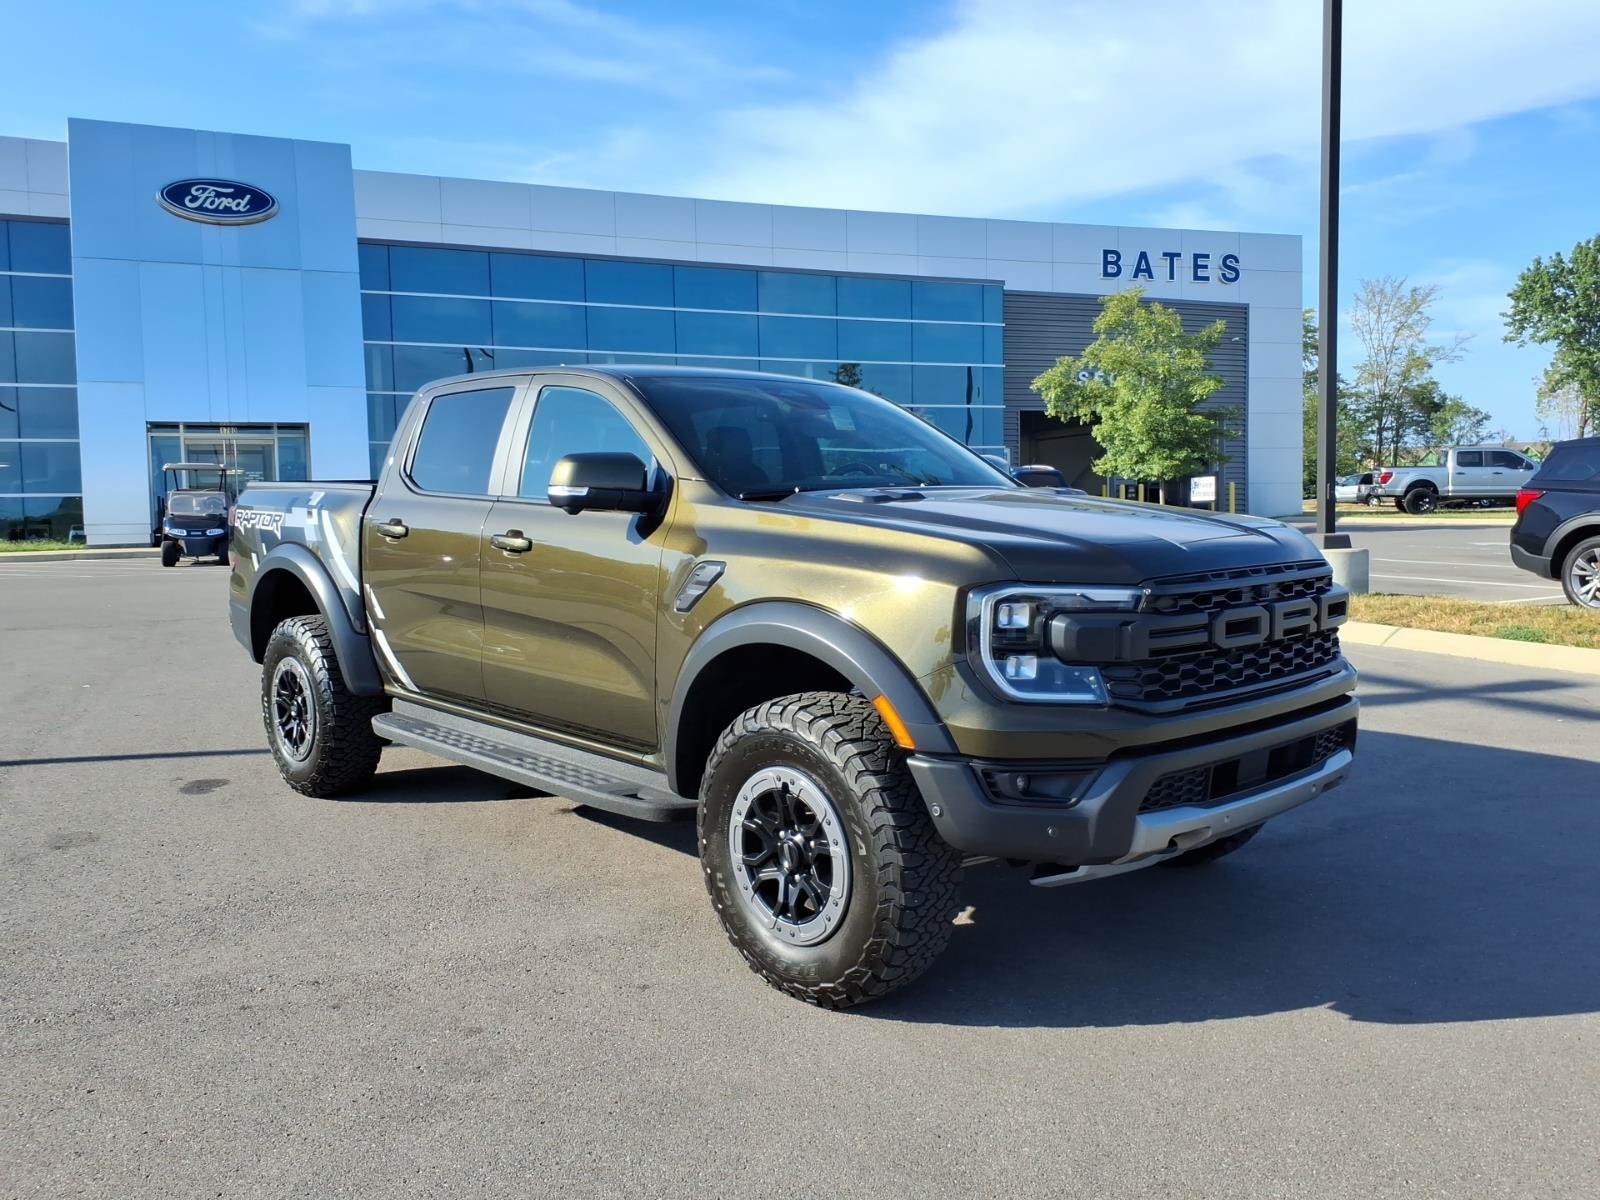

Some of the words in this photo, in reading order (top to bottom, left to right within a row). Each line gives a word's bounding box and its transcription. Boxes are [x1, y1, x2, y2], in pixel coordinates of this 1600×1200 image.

[185, 184, 251, 212] Ford
[1102, 249, 1240, 283] BATES
[235, 509, 285, 539] RAPTOR
[1119, 584, 1349, 661] FORD
